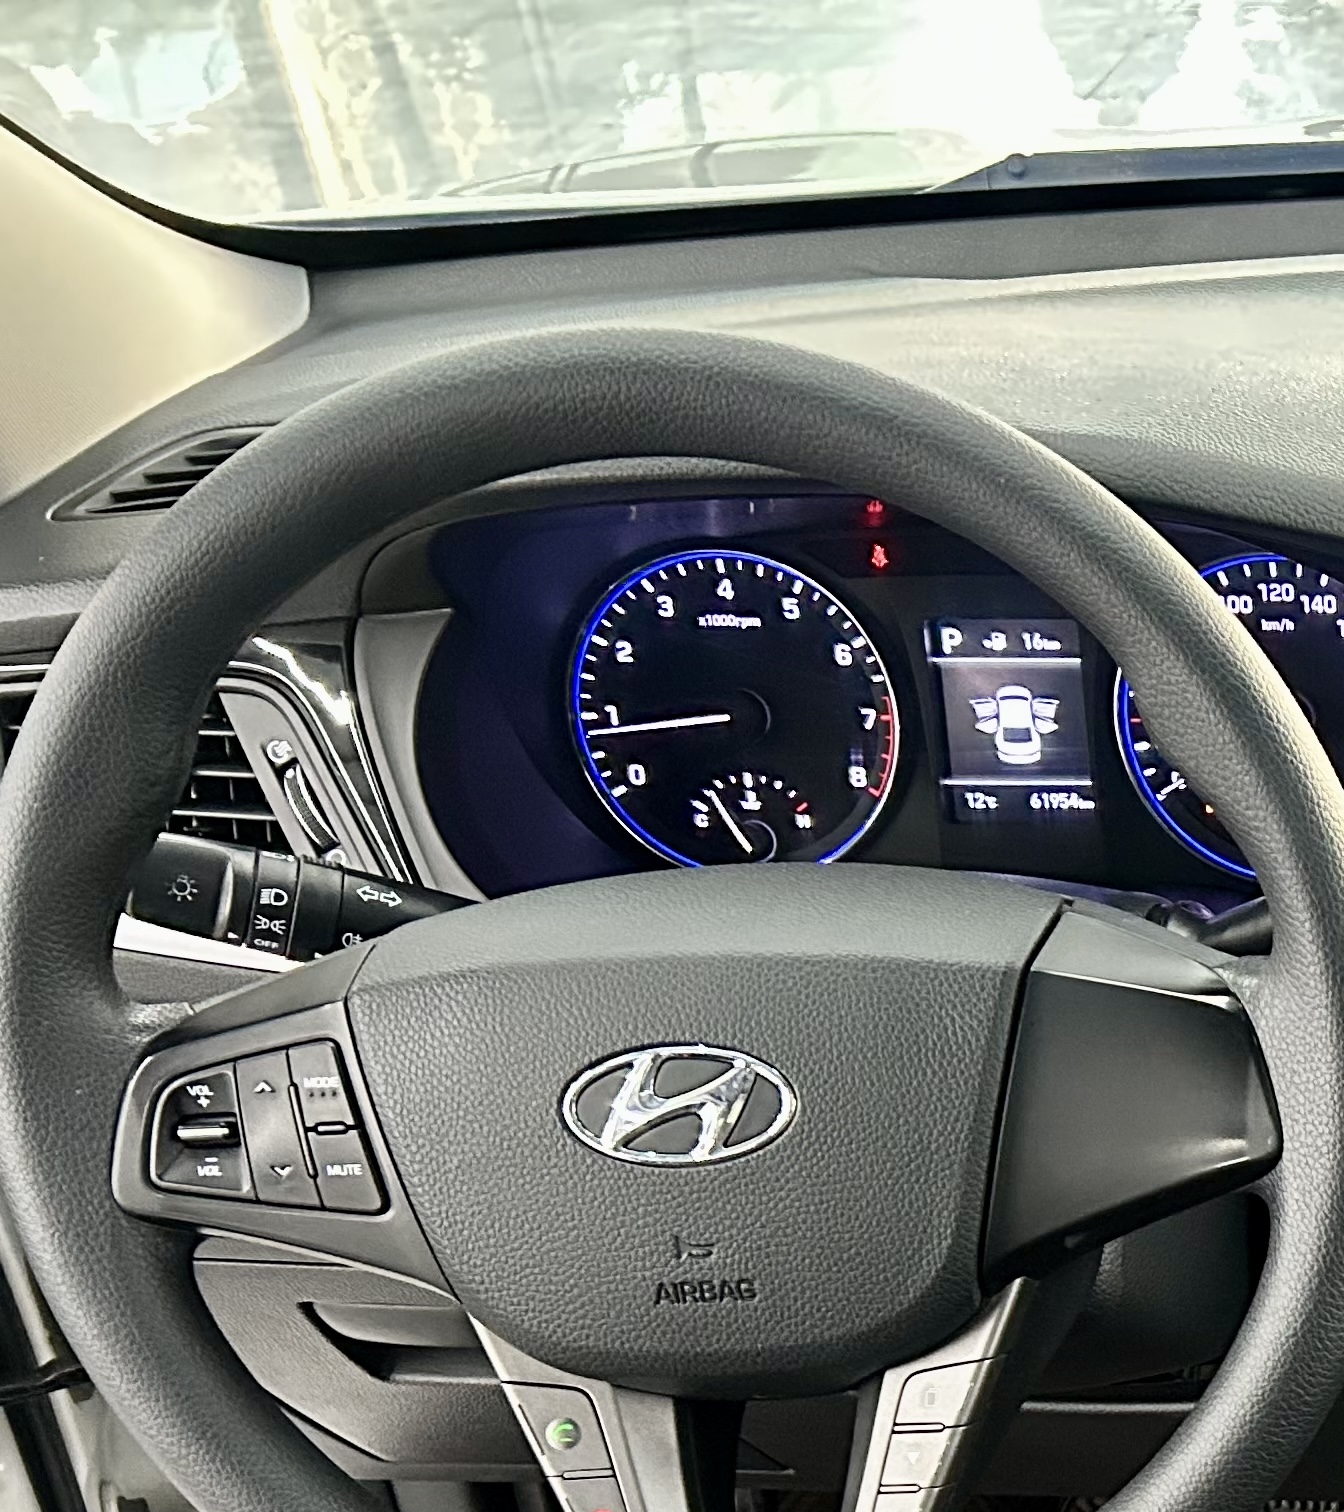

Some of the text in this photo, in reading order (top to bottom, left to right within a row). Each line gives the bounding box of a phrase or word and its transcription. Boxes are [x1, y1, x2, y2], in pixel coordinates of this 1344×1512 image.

[716, 578, 735, 601] 4
[1256, 582, 1295, 603] 120
[656, 594, 675, 618] 3
[781, 597, 801, 620] 5
[1299, 594, 1338, 615] 140
[1260, 617, 1295, 632] km/h
[615, 640, 634, 663] 2
[940, 627, 964, 655] P
[833, 642, 853, 666] 6
[604, 705, 620, 726] 1
[858, 707, 877, 731] 7
[626, 763, 647, 786] 0
[848, 765, 868, 788] 8
[253, 938, 280, 949] OFF
[186, 1084, 215, 1097] VOL
[303, 1075, 341, 1089] MODE
[196, 1164, 223, 1177] VOL
[326, 1163, 363, 1176] MUTE
[653, 1278, 758, 1305] AIRBAG
